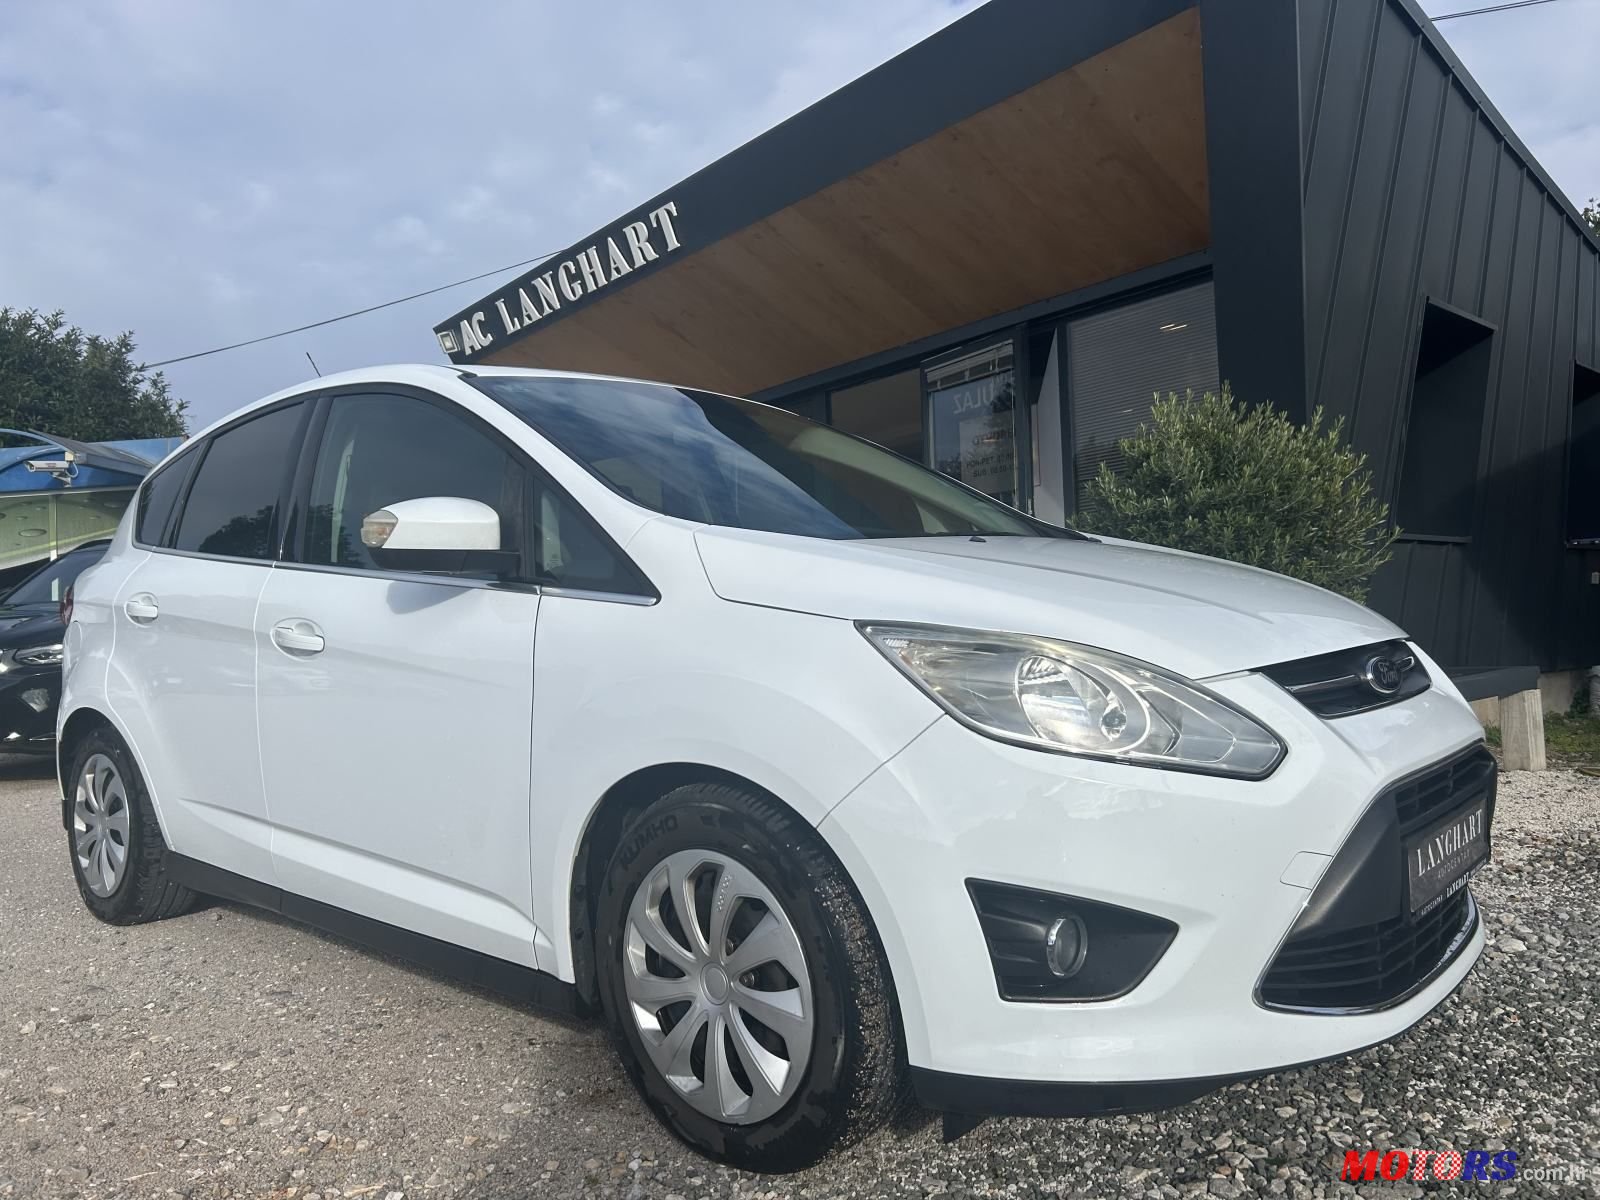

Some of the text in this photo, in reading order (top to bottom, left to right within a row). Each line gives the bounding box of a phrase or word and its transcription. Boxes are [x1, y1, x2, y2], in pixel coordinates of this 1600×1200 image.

[459, 201, 681, 355] AC LANGHART
[1378, 661, 1399, 684] Ford
[619, 814, 679, 872] KUMHO
[1417, 809, 1482, 877] LANGHART
[1446, 871, 1470, 898] LANGHART
